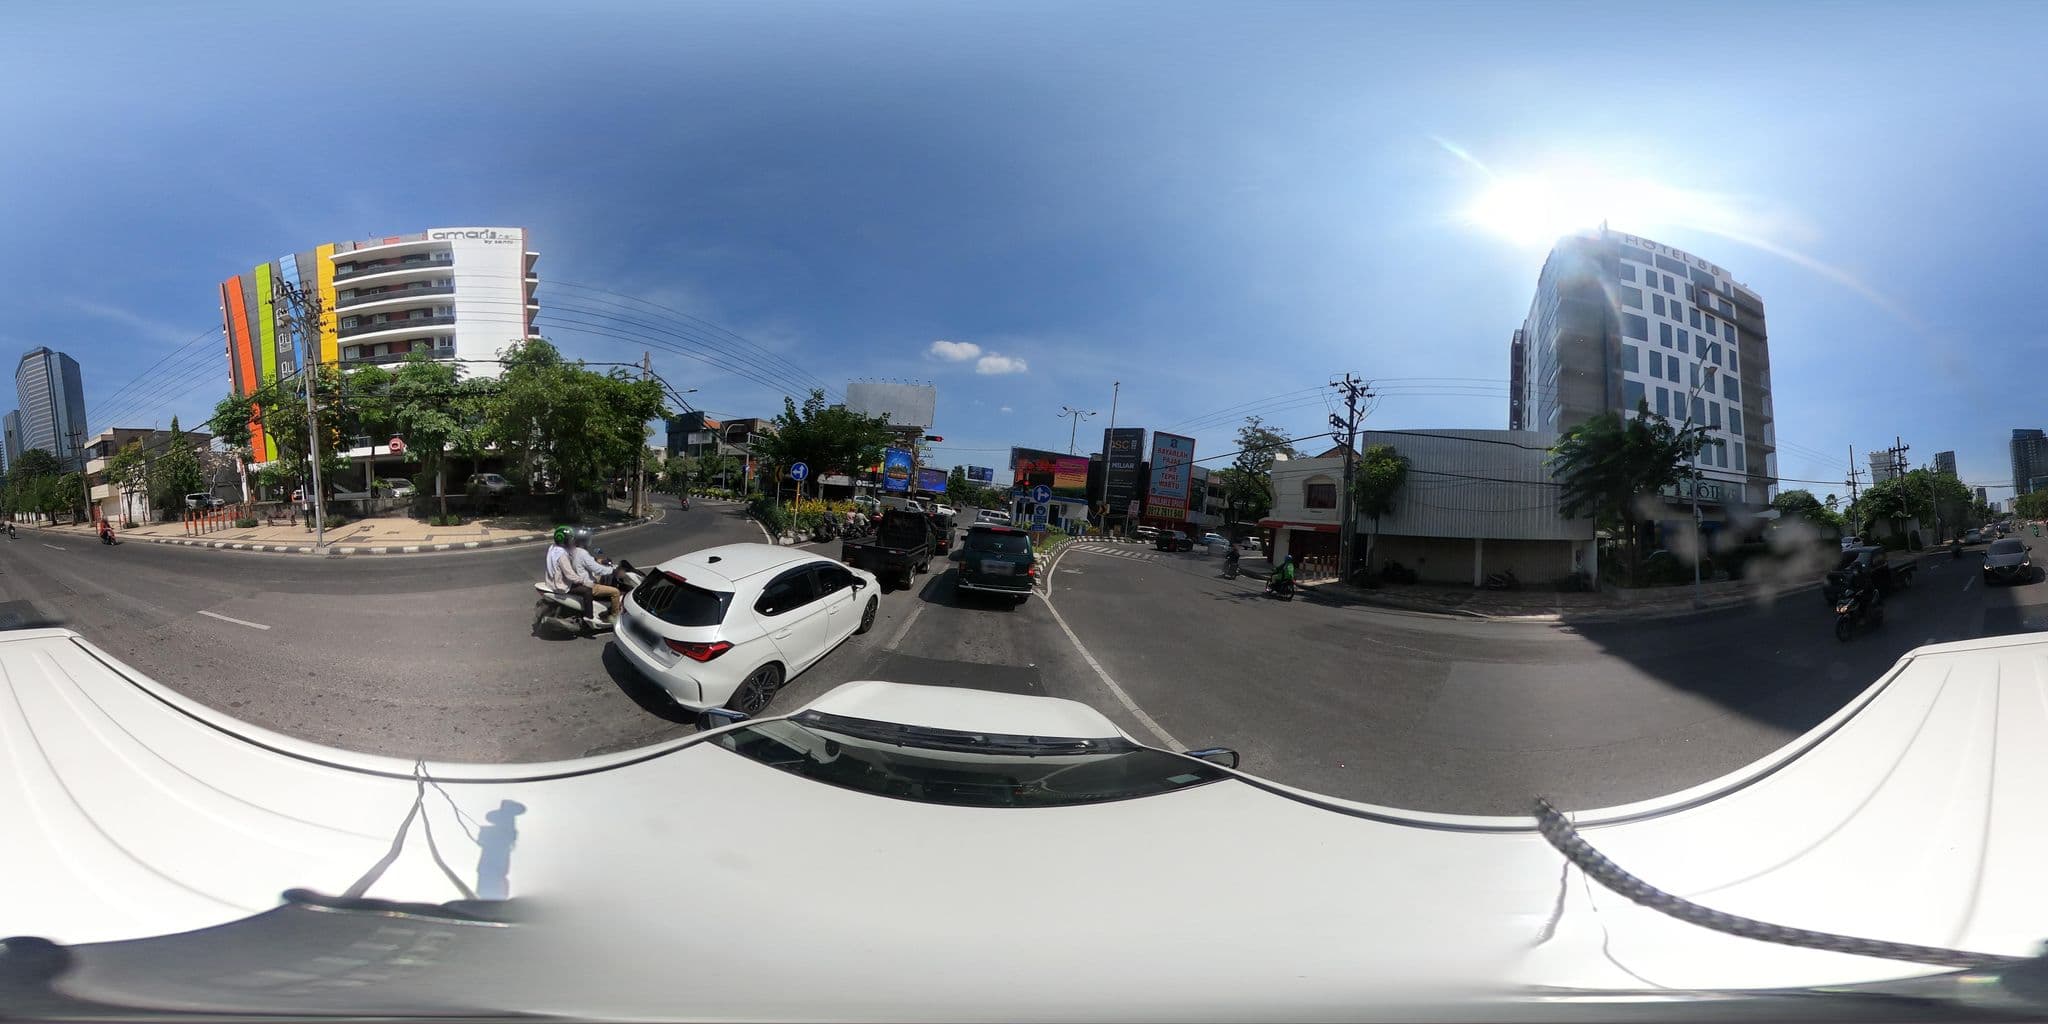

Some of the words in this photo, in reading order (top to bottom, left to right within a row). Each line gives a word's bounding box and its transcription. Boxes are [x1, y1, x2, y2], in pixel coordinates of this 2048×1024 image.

[432, 229, 496, 240] amaris
[1625, 236, 1690, 263] HOTEL
[1697, 258, 1720, 276] 88
